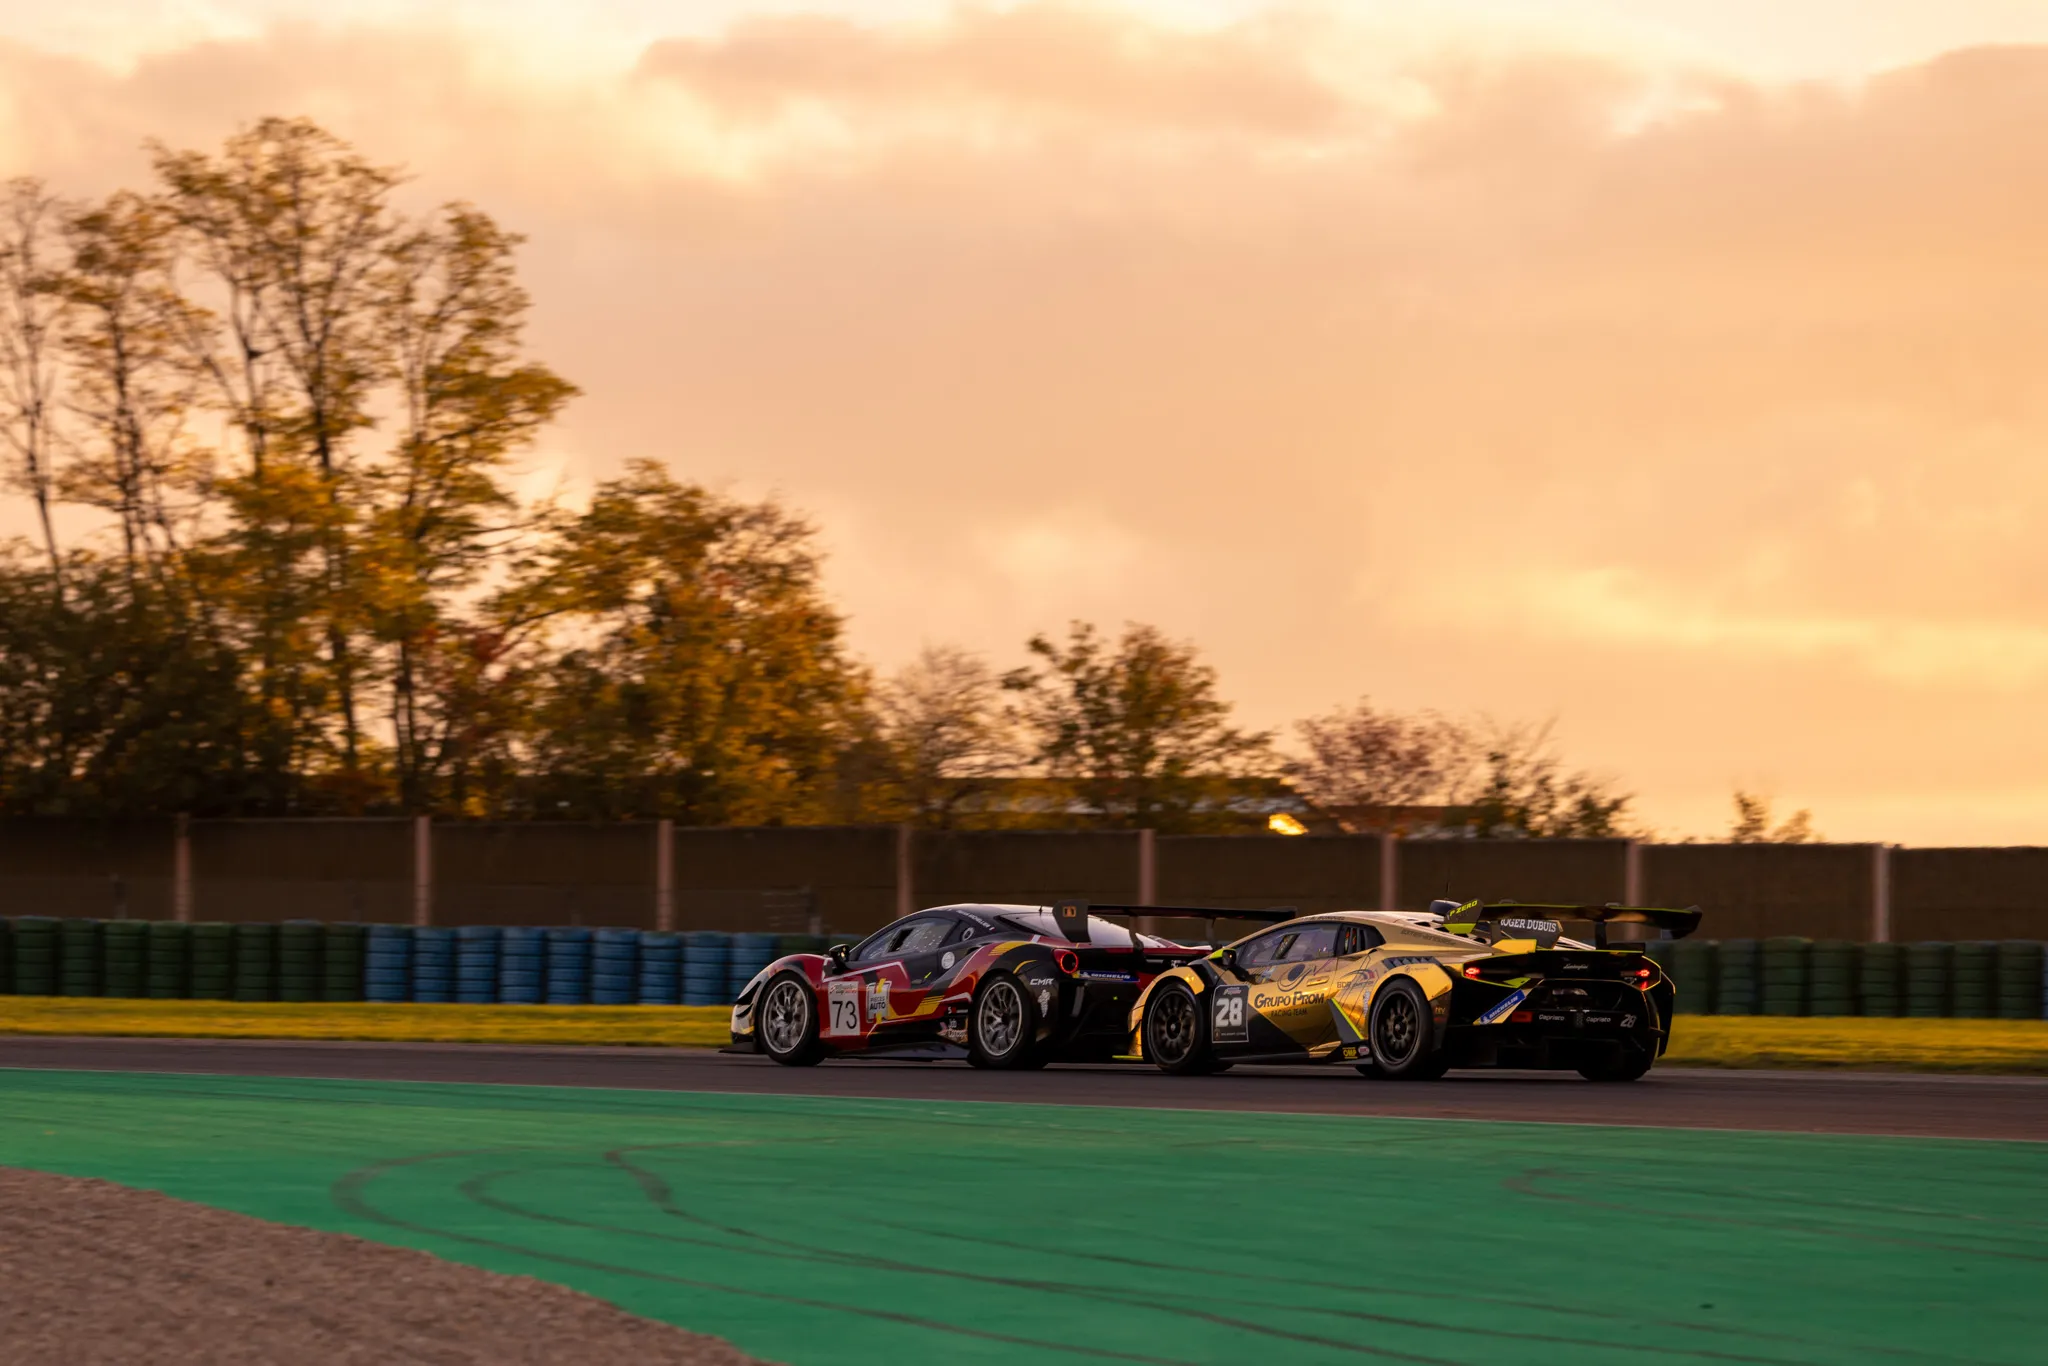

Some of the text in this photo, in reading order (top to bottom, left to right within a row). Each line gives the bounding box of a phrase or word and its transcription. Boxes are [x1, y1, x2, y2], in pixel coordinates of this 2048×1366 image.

[1455, 899, 1478, 914] ZERO
[1526, 919, 1557, 933] DUBUIS
[869, 1002, 886, 1011] AUTO
[1215, 996, 1243, 1028] 28
[1293, 1007, 1308, 1015] TEAM
[1489, 995, 1519, 1019] MICHELIN
[832, 1000, 858, 1030] 73
[1620, 1014, 1637, 1029] 28
